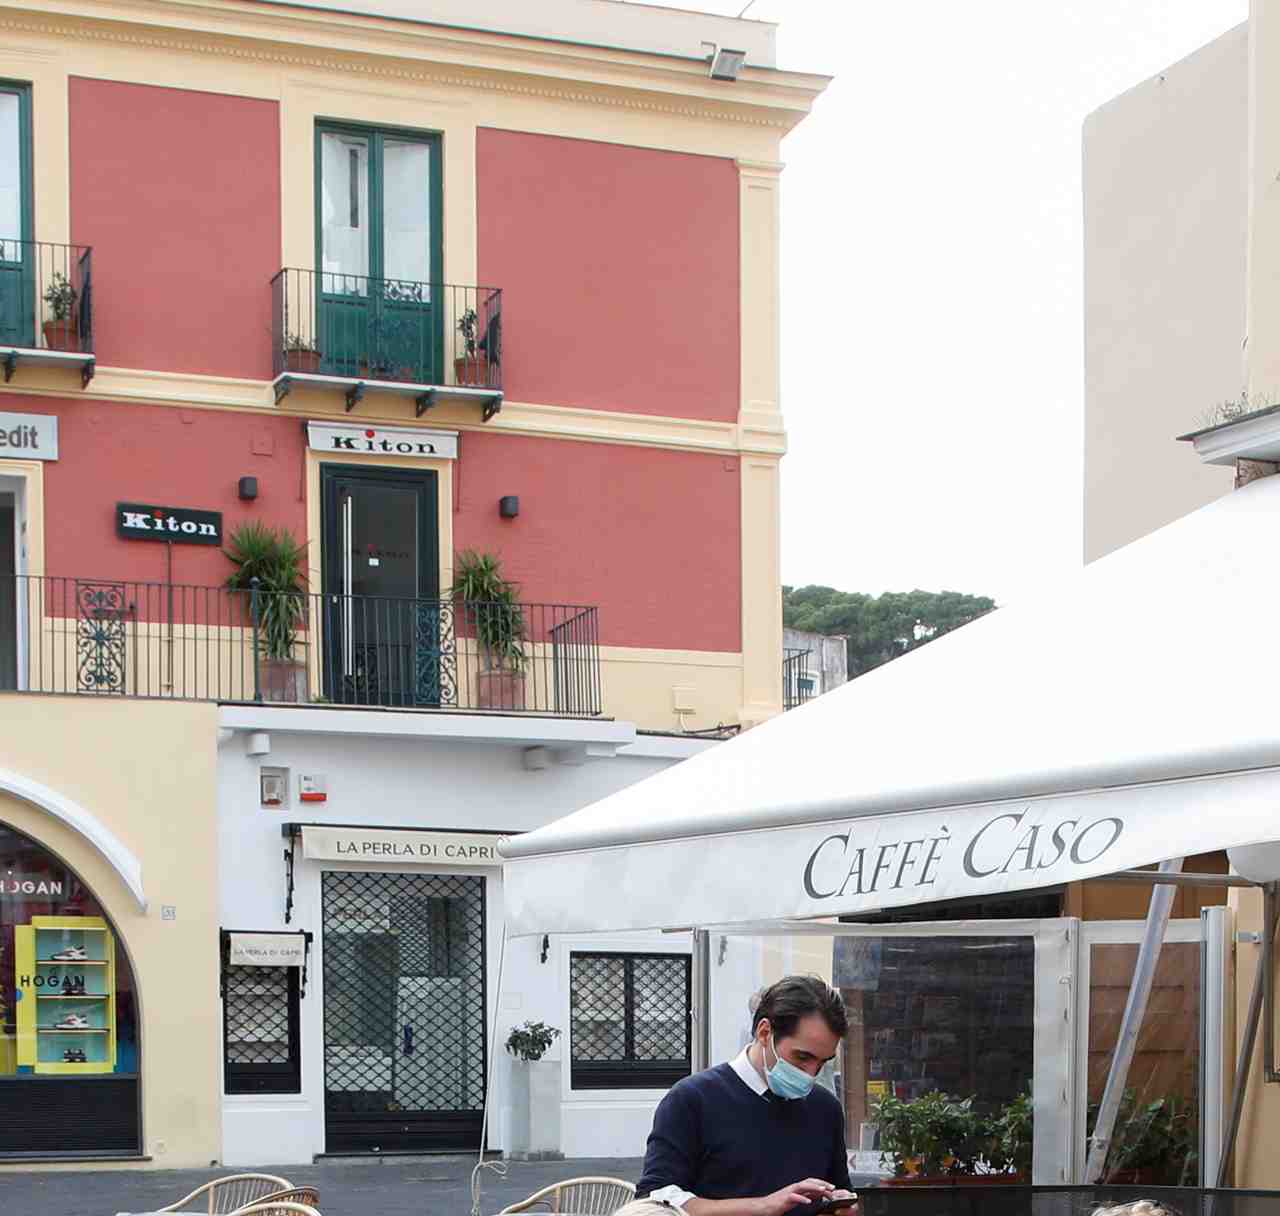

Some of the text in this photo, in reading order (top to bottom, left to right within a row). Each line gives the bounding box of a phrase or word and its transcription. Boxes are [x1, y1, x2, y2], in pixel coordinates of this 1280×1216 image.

[331, 429, 437, 454] Kiton
[122, 510, 218, 536] Kiton
[336, 841, 494, 859] LA PERLA DI CAPRI
[803, 808, 1124, 899] CAFFÈ CASO
[20, 975, 85, 987] HOGAN
